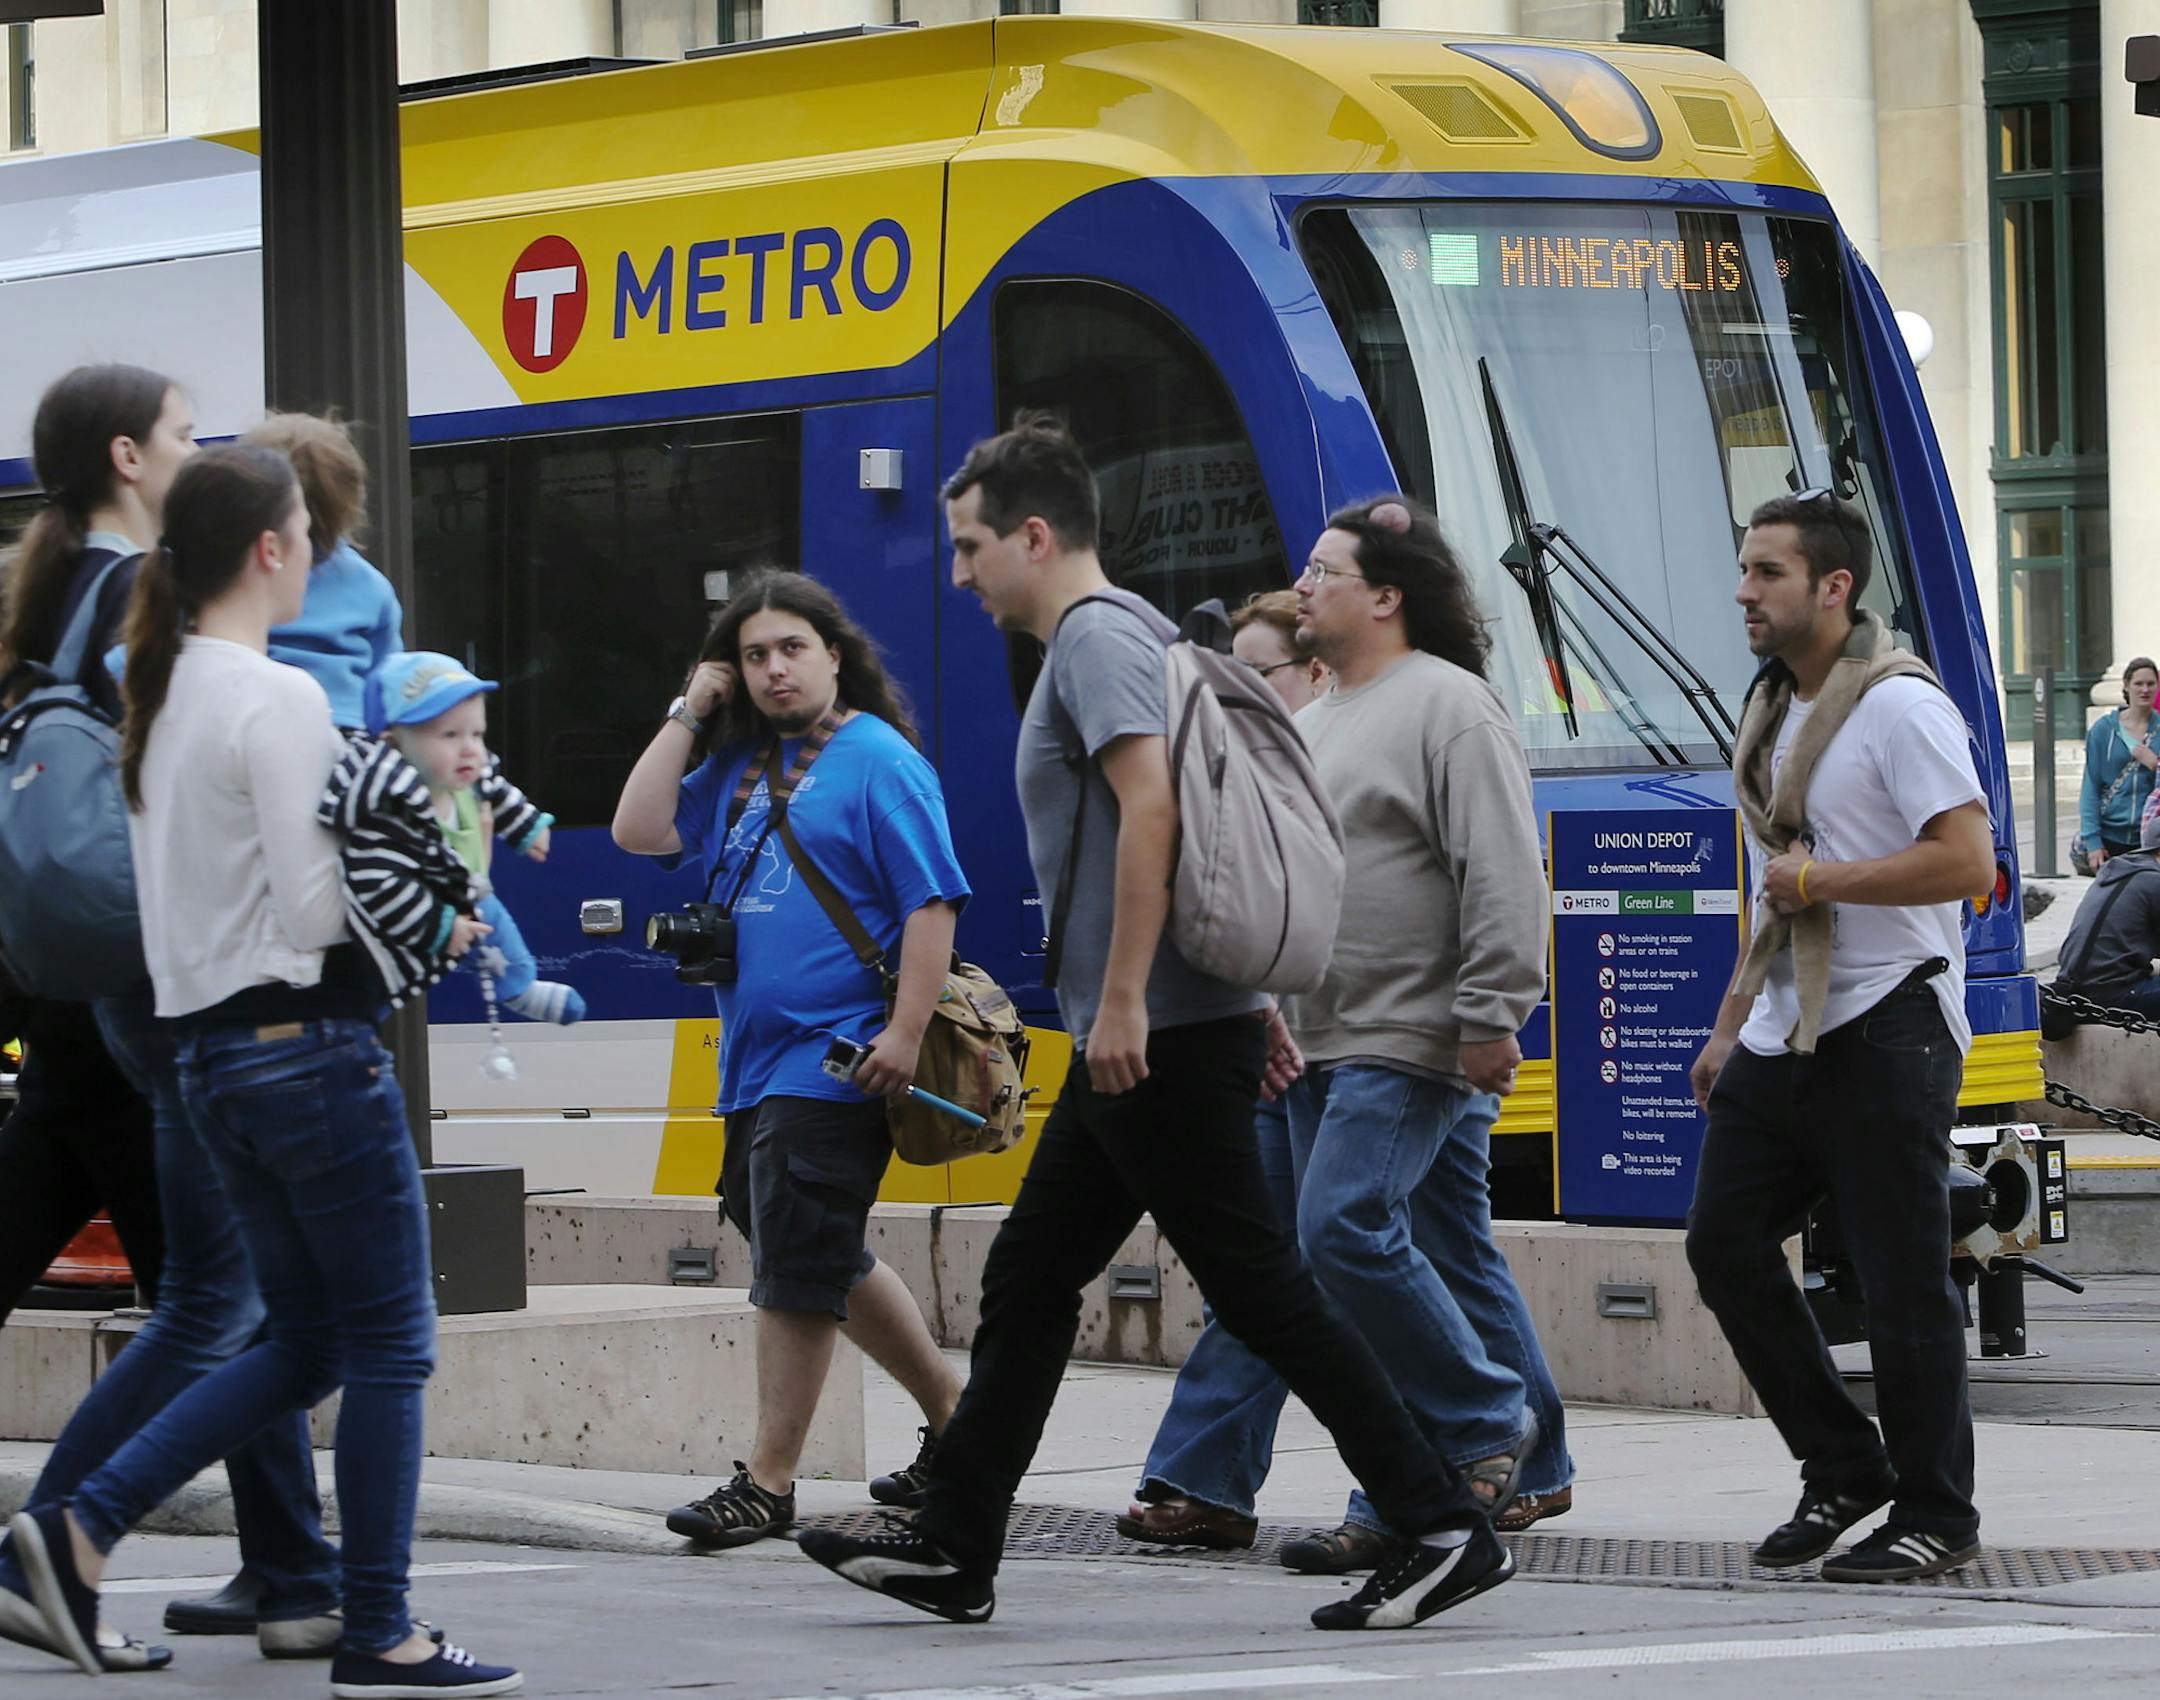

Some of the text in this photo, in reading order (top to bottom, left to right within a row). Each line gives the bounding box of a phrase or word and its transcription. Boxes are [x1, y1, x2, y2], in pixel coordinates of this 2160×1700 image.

[1500, 234, 1742, 293] MINNEAPOLIS
[512, 217, 911, 360] T METRO
[1704, 358, 1743, 380] EPOT
[1594, 831, 1694, 849] UNION DEPOT
[1588, 860, 1701, 876] to downtown Minneapolis
[1575, 896, 1610, 909] METRO
[1624, 895, 1653, 909] Green
[1654, 895, 1675, 910] Line
[1618, 933, 1693, 946] No smoking in station
[1618, 946, 1679, 956] areas or on trains
[1619, 968, 1699, 981] No food or beverage in
[1619, 981, 1674, 993] open containers
[1620, 1003, 1658, 1013] No alcohol
[1620, 1026, 1713, 1039] No skating or skateboardin
[703, 1033, 720, 1049] As
[1620, 1038, 1693, 1049] bikes must be walked
[1621, 1060, 1683, 1072] No music without
[1621, 1072, 1663, 1085] headphones
[1621, 1095, 1662, 1106] Unattended
[1641, 1108, 1655, 1118] will
[1655, 1108, 1665, 1118] be
[1665, 1108, 1697, 1119] removed
[1622, 1130, 1665, 1144] No loitering
[1623, 1152, 1639, 1163] This
[1639, 1155, 1655, 1163] area
[1655, 1154, 1662, 1163] is
[1662, 1153, 1682, 1167] being
[1623, 1165, 1676, 1176] video recorded
